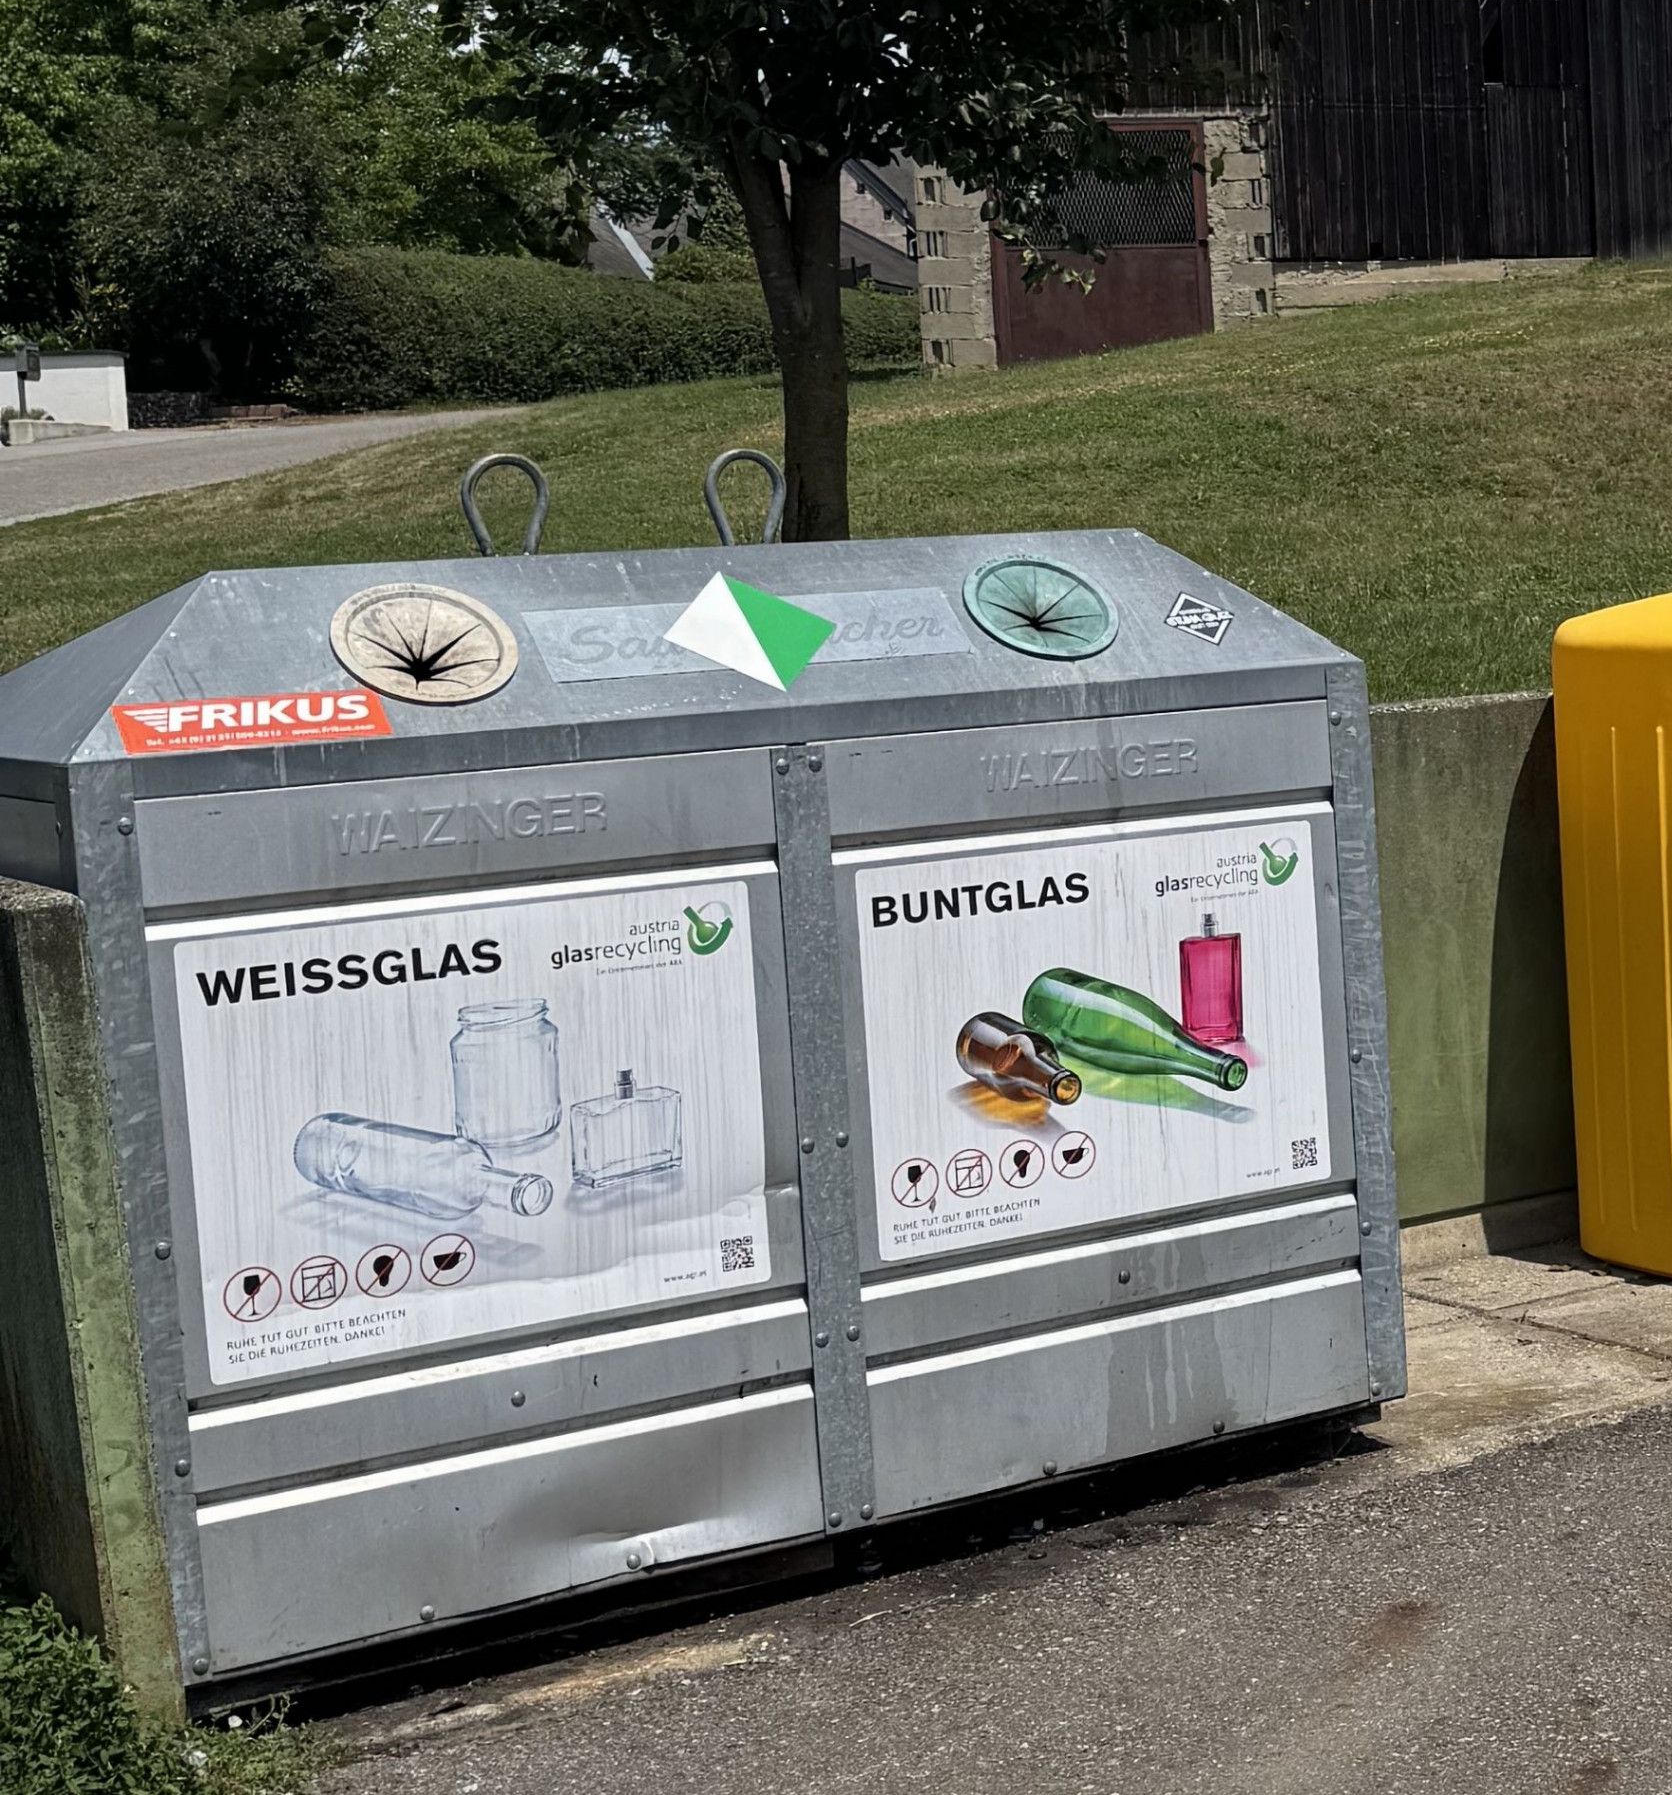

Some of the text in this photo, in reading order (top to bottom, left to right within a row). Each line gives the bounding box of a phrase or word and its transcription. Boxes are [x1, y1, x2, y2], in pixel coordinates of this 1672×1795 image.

[167, 694, 370, 732] FRIKUS
[979, 738, 1199, 792] WAIZINGER
[331, 791, 608, 855] WAIZINGER
[1216, 852, 1257, 868] austria
[870, 871, 1090, 928] BUNTGLAS
[1155, 867, 1258, 897] glasrecycling
[629, 920, 680, 936] austria
[195, 937, 503, 1006] WEISSGLAS
[551, 935, 681, 970] glasrecycling
[893, 1220, 919, 1233] RUHE
[921, 1216, 939, 1227] TUT
[965, 1206, 991, 1219] BITTE
[993, 1198, 1041, 1214] BEACHTEN
[894, 1235, 908, 1245] SIE
[911, 1232, 926, 1242] DIE
[226, 1336, 257, 1351] RUHE
[261, 1331, 281, 1344] TUT
[314, 1319, 345, 1334] BITTE
[349, 1308, 407, 1327] BEACHTEN
[228, 1352, 245, 1365] SIE
[248, 1349, 267, 1362] DIE
[344, 1326, 386, 1343] DANKE!
